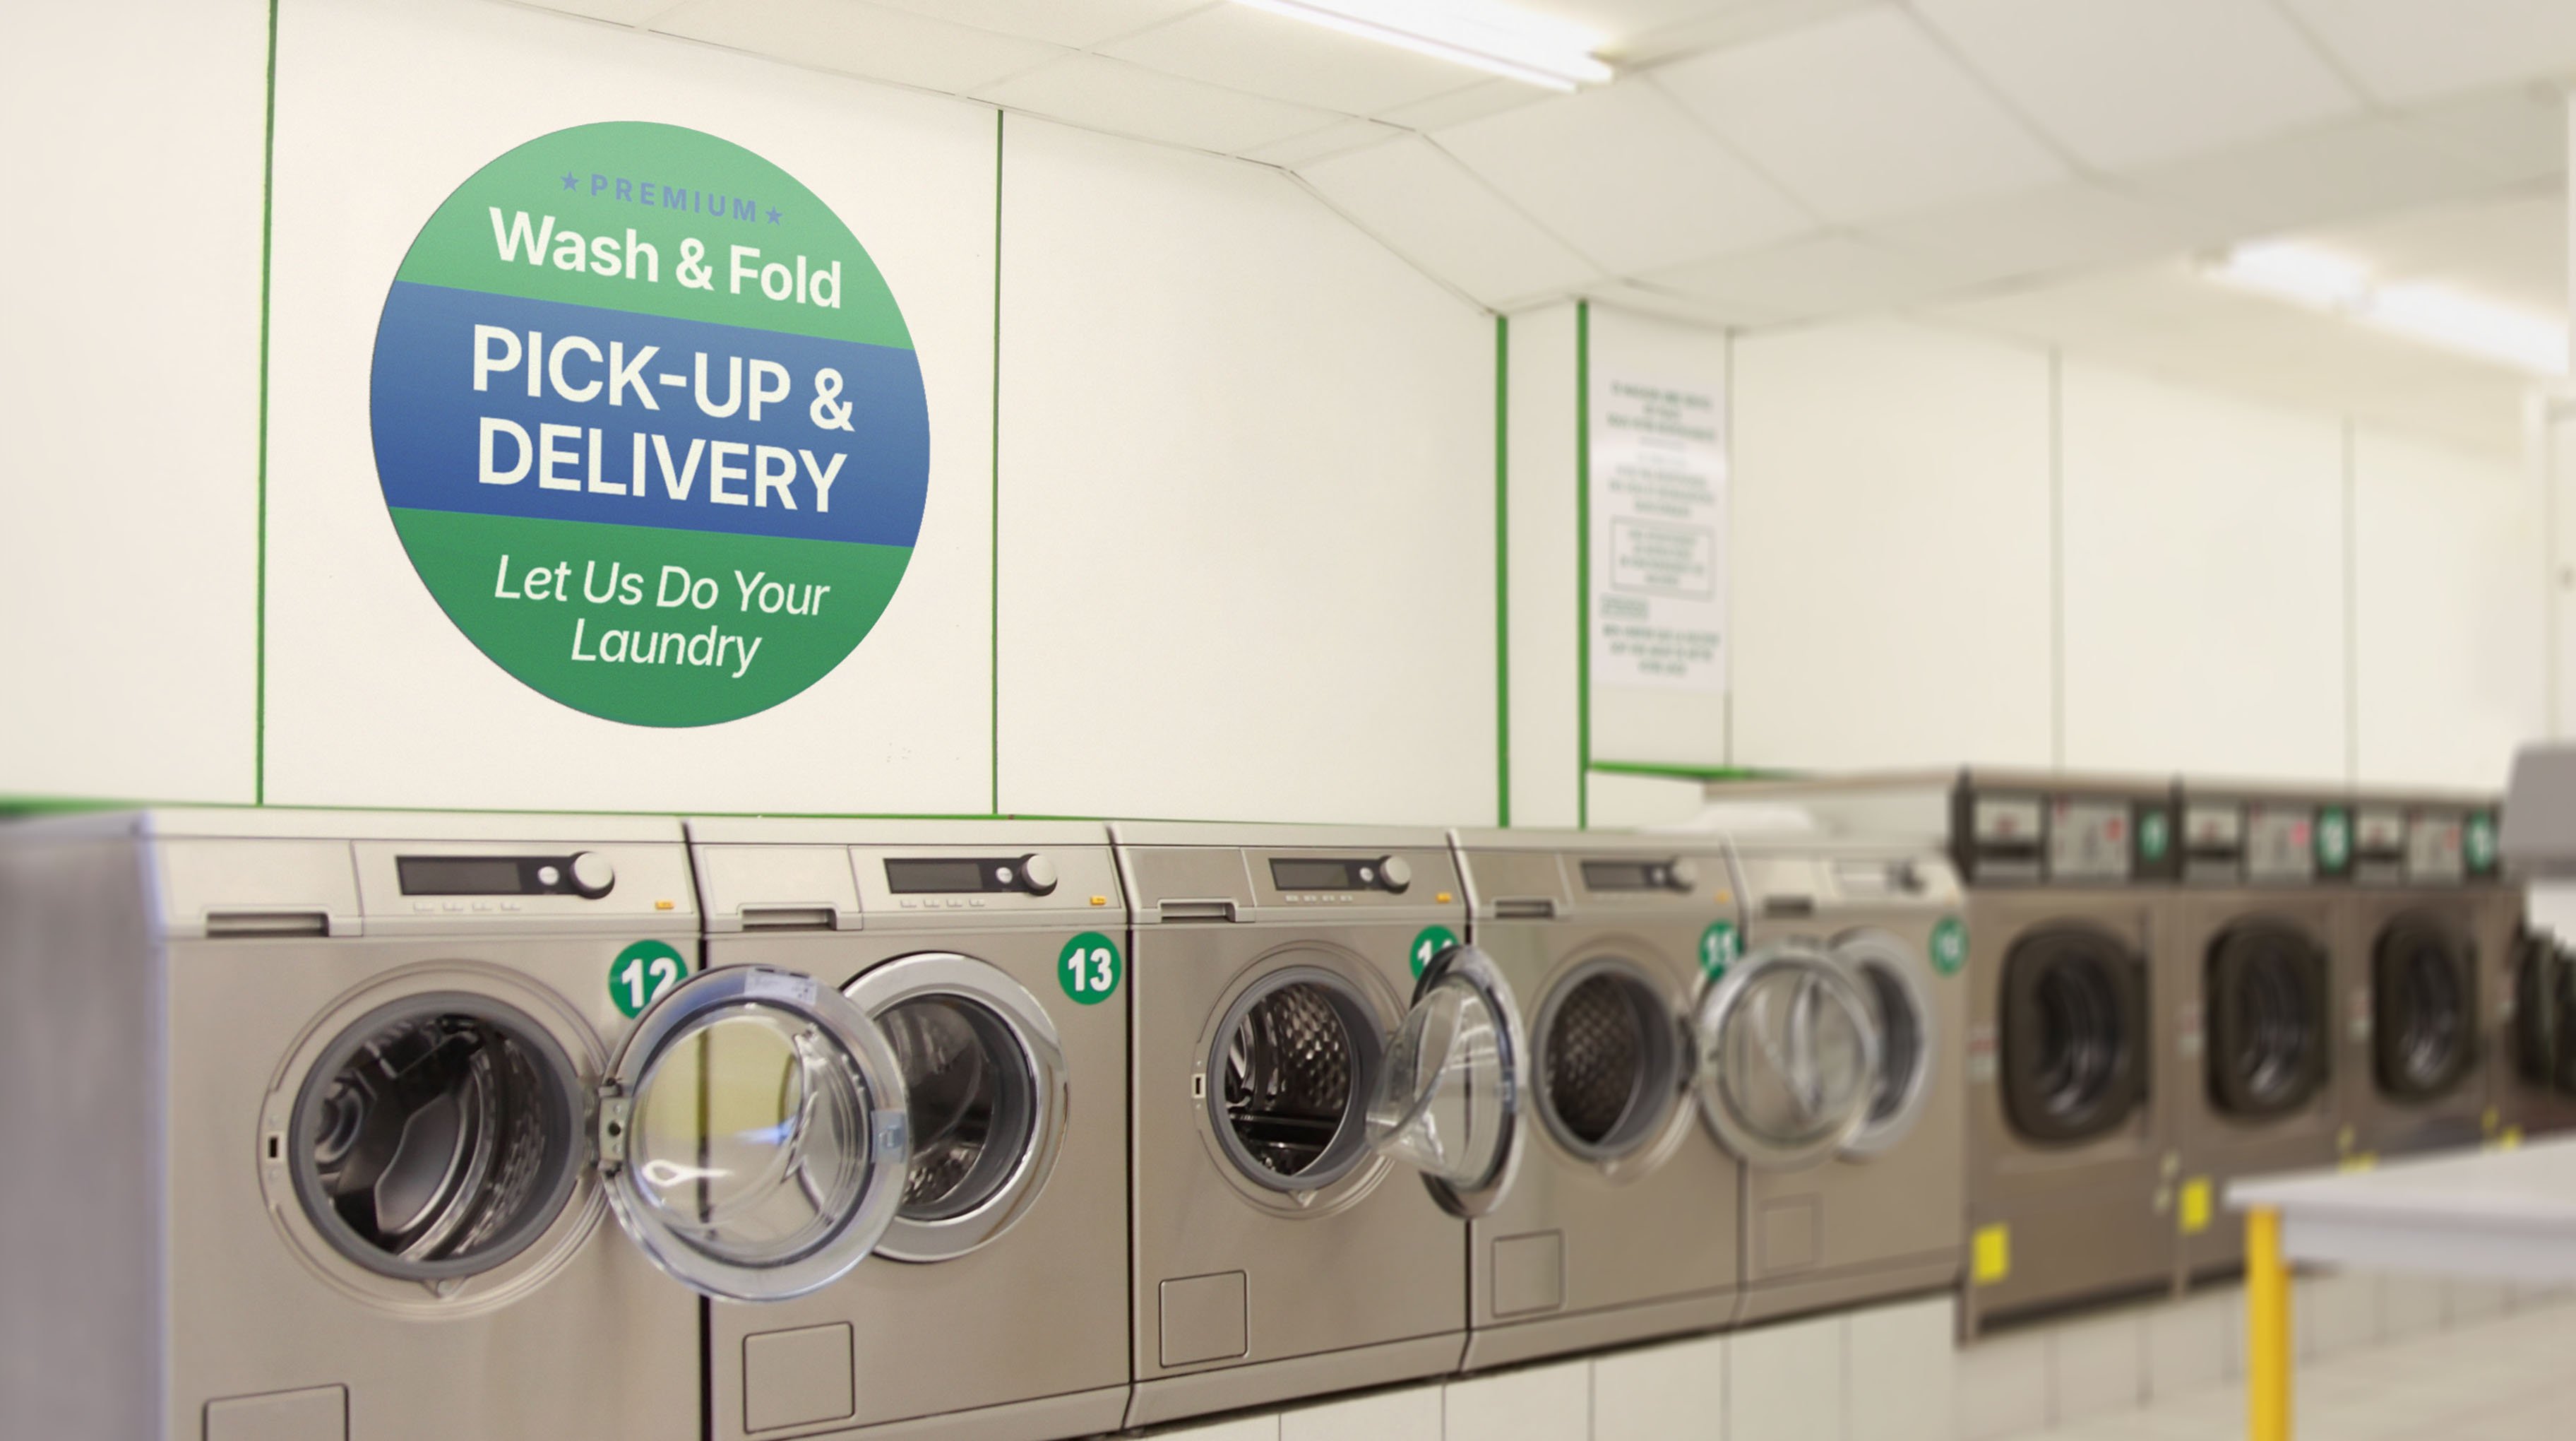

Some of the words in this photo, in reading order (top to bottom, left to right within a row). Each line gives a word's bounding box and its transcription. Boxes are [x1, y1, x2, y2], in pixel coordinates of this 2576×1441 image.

[590, 174, 756, 223] PREMIUM
[489, 206, 660, 283] Wash
[675, 237, 715, 292] &
[729, 244, 842, 309] Fold
[472, 324, 791, 422] PICK-UP
[809, 367, 855, 432] &
[478, 417, 847, 513] DELIVERY
[494, 555, 571, 602] Let
[583, 560, 644, 605] Us
[656, 565, 719, 610] Do
[734, 570, 830, 616] Your
[571, 618, 762, 678] Laundry
[621, 956, 678, 1009] 12
[1068, 947, 1113, 992] 13
